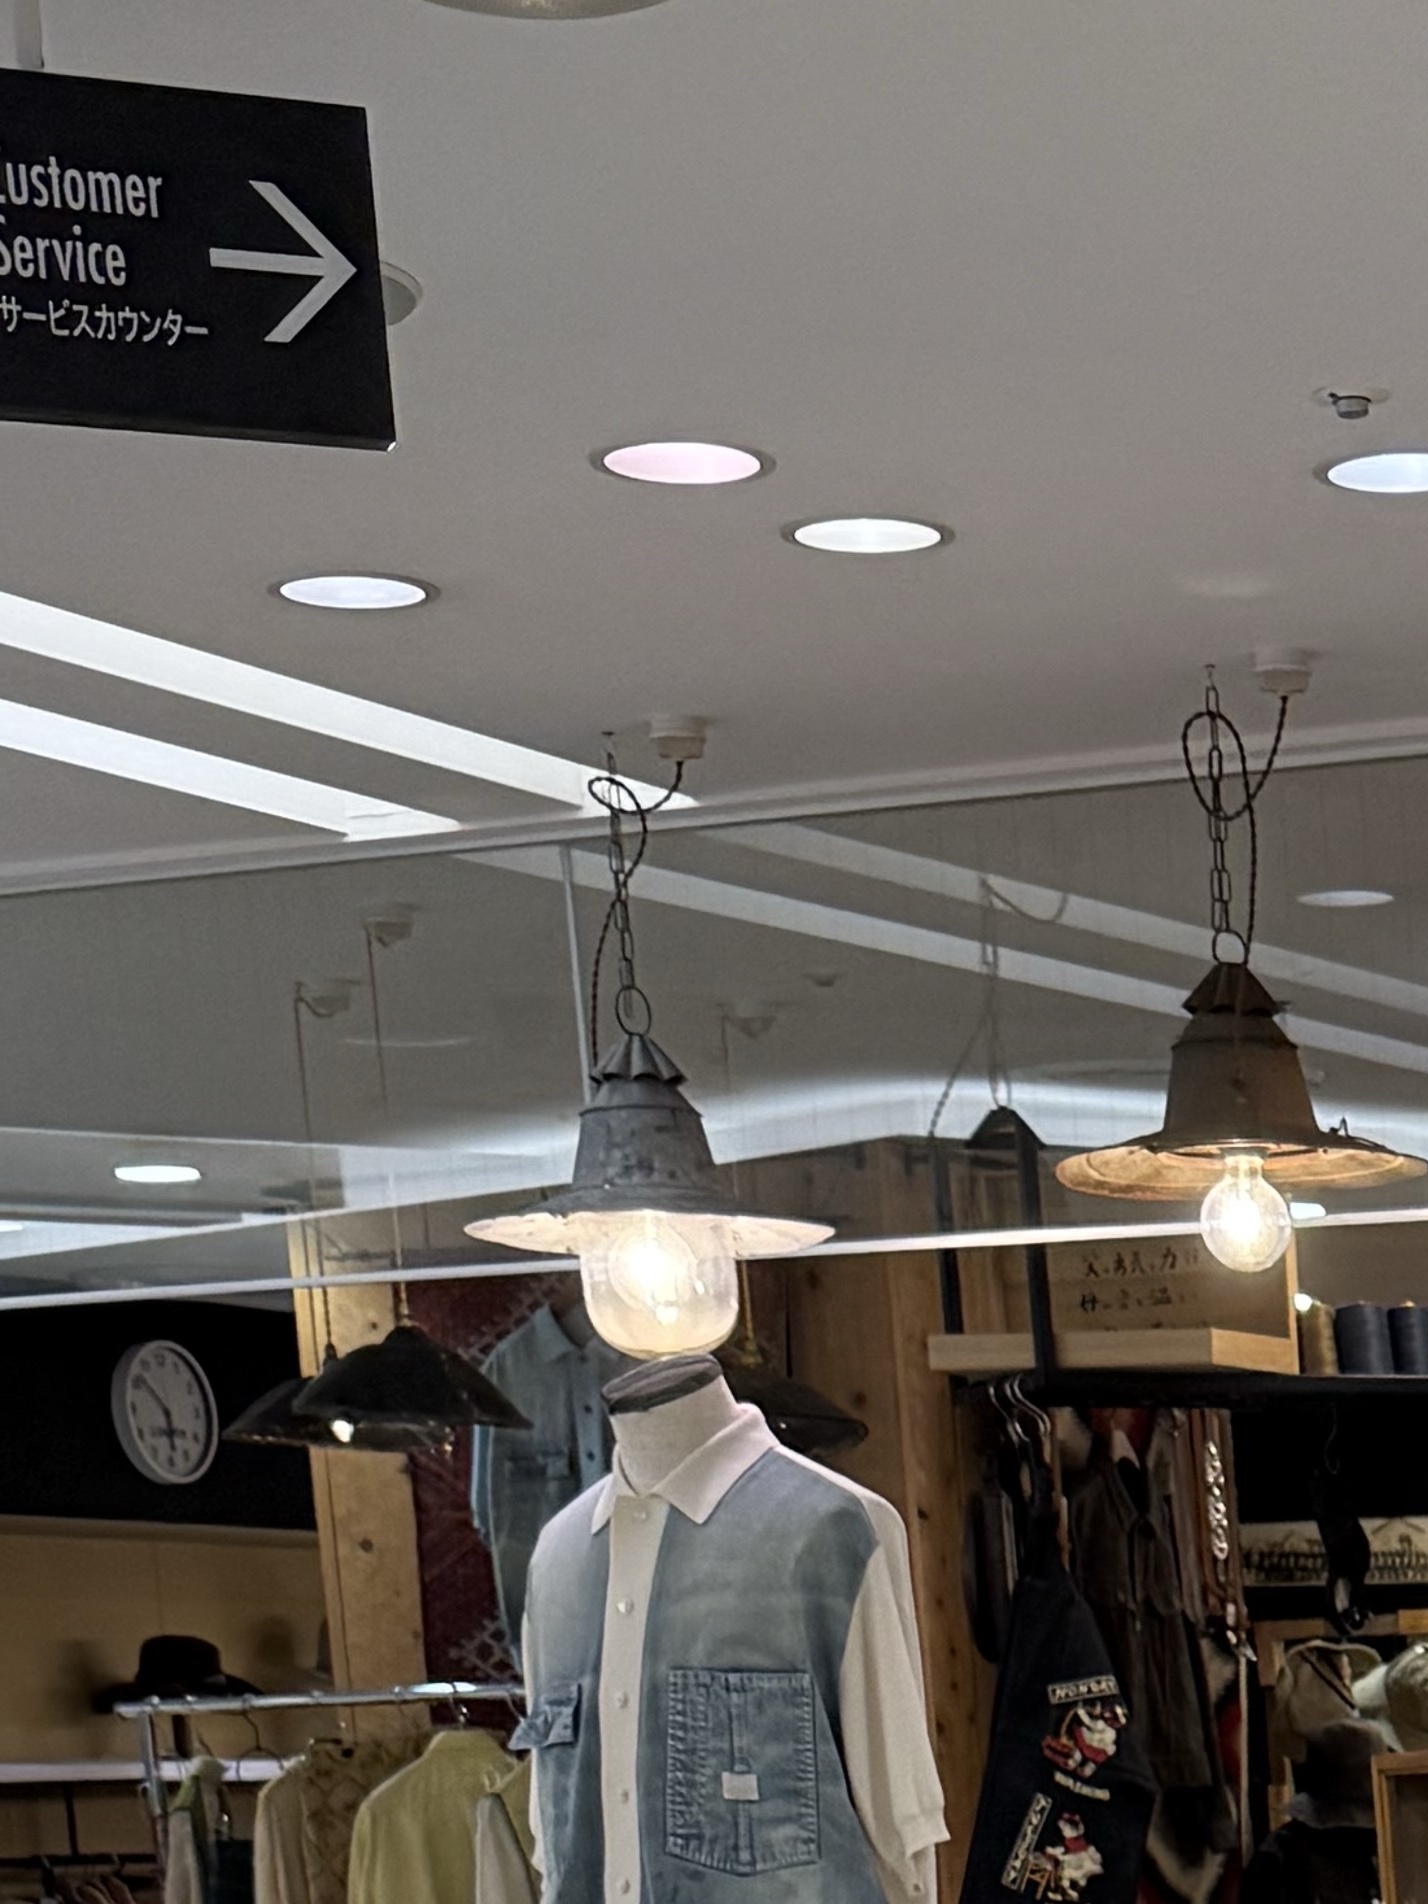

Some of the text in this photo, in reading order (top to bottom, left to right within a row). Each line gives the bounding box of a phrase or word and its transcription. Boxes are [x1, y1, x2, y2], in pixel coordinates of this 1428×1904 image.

[0, 154, 163, 219] ustomer
[0, 294, 209, 346] サービスカウンター
